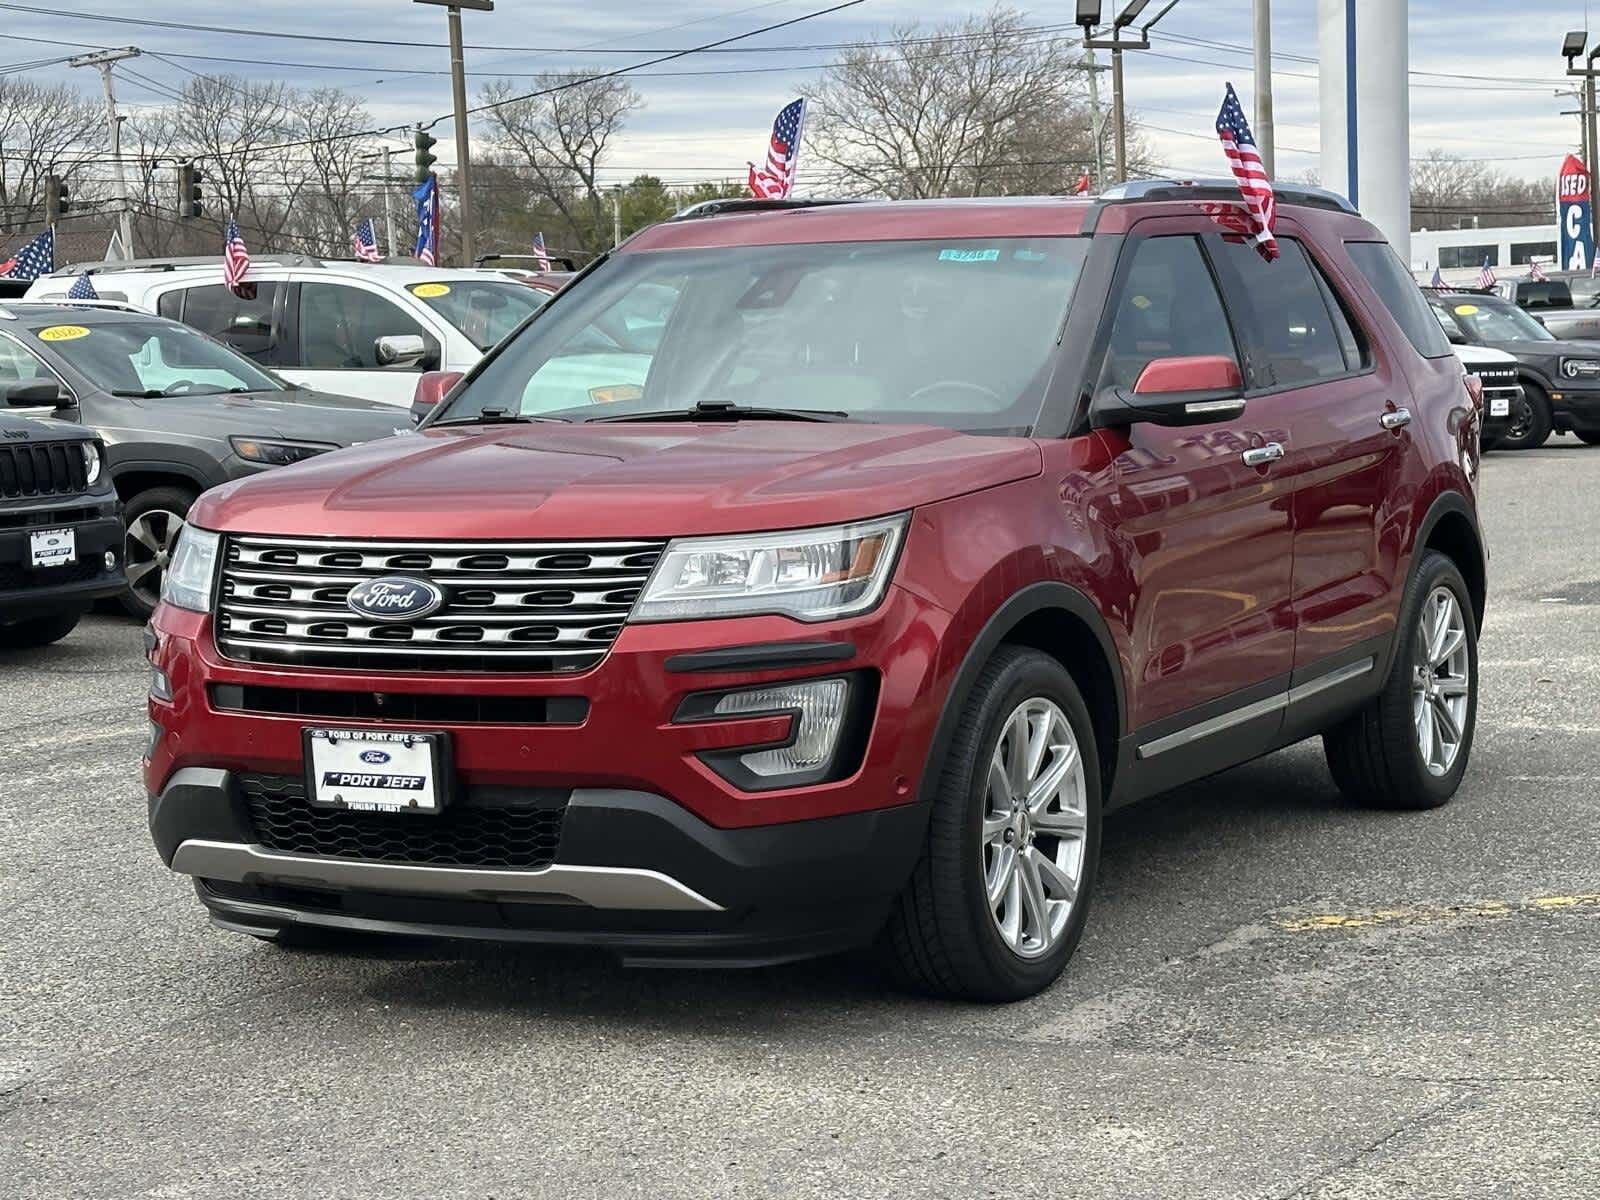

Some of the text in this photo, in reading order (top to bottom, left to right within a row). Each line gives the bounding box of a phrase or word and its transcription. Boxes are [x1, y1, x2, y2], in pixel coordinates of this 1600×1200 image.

[363, 582, 417, 608] Ford
[328, 730, 351, 739] FORD
[352, 732, 363, 740] OF
[365, 732, 388, 741] PORT
[365, 751, 385, 763] Ford
[339, 774, 382, 786] PORT
[383, 776, 421, 789] JEFF
[377, 802, 402, 813] FIRST
